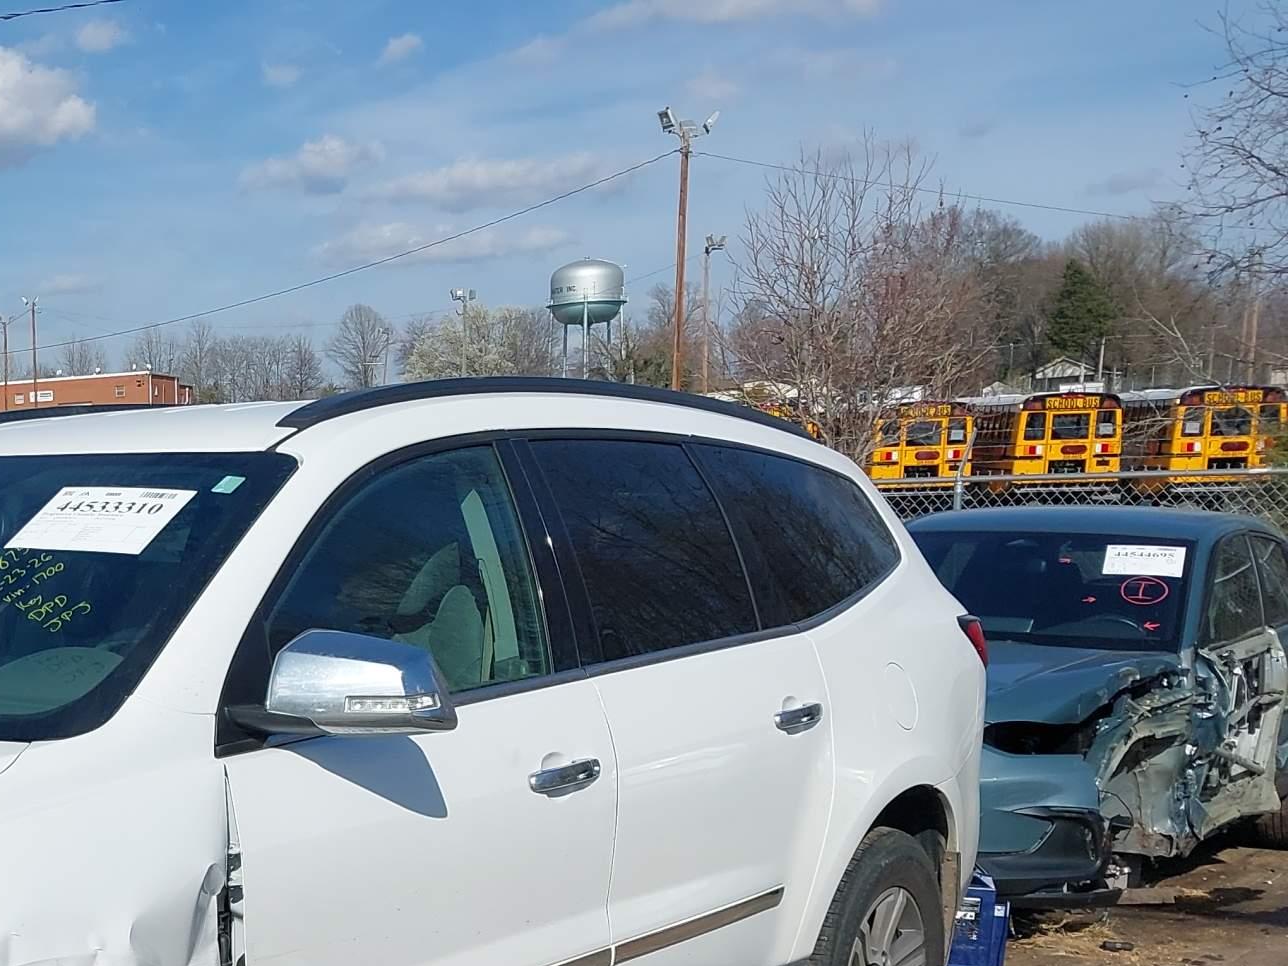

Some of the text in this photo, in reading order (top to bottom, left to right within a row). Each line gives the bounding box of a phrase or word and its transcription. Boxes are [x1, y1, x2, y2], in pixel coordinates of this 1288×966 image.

[1047, 398, 1098, 409] SCHOOL BUS
[56, 500, 165, 515] 44533310
